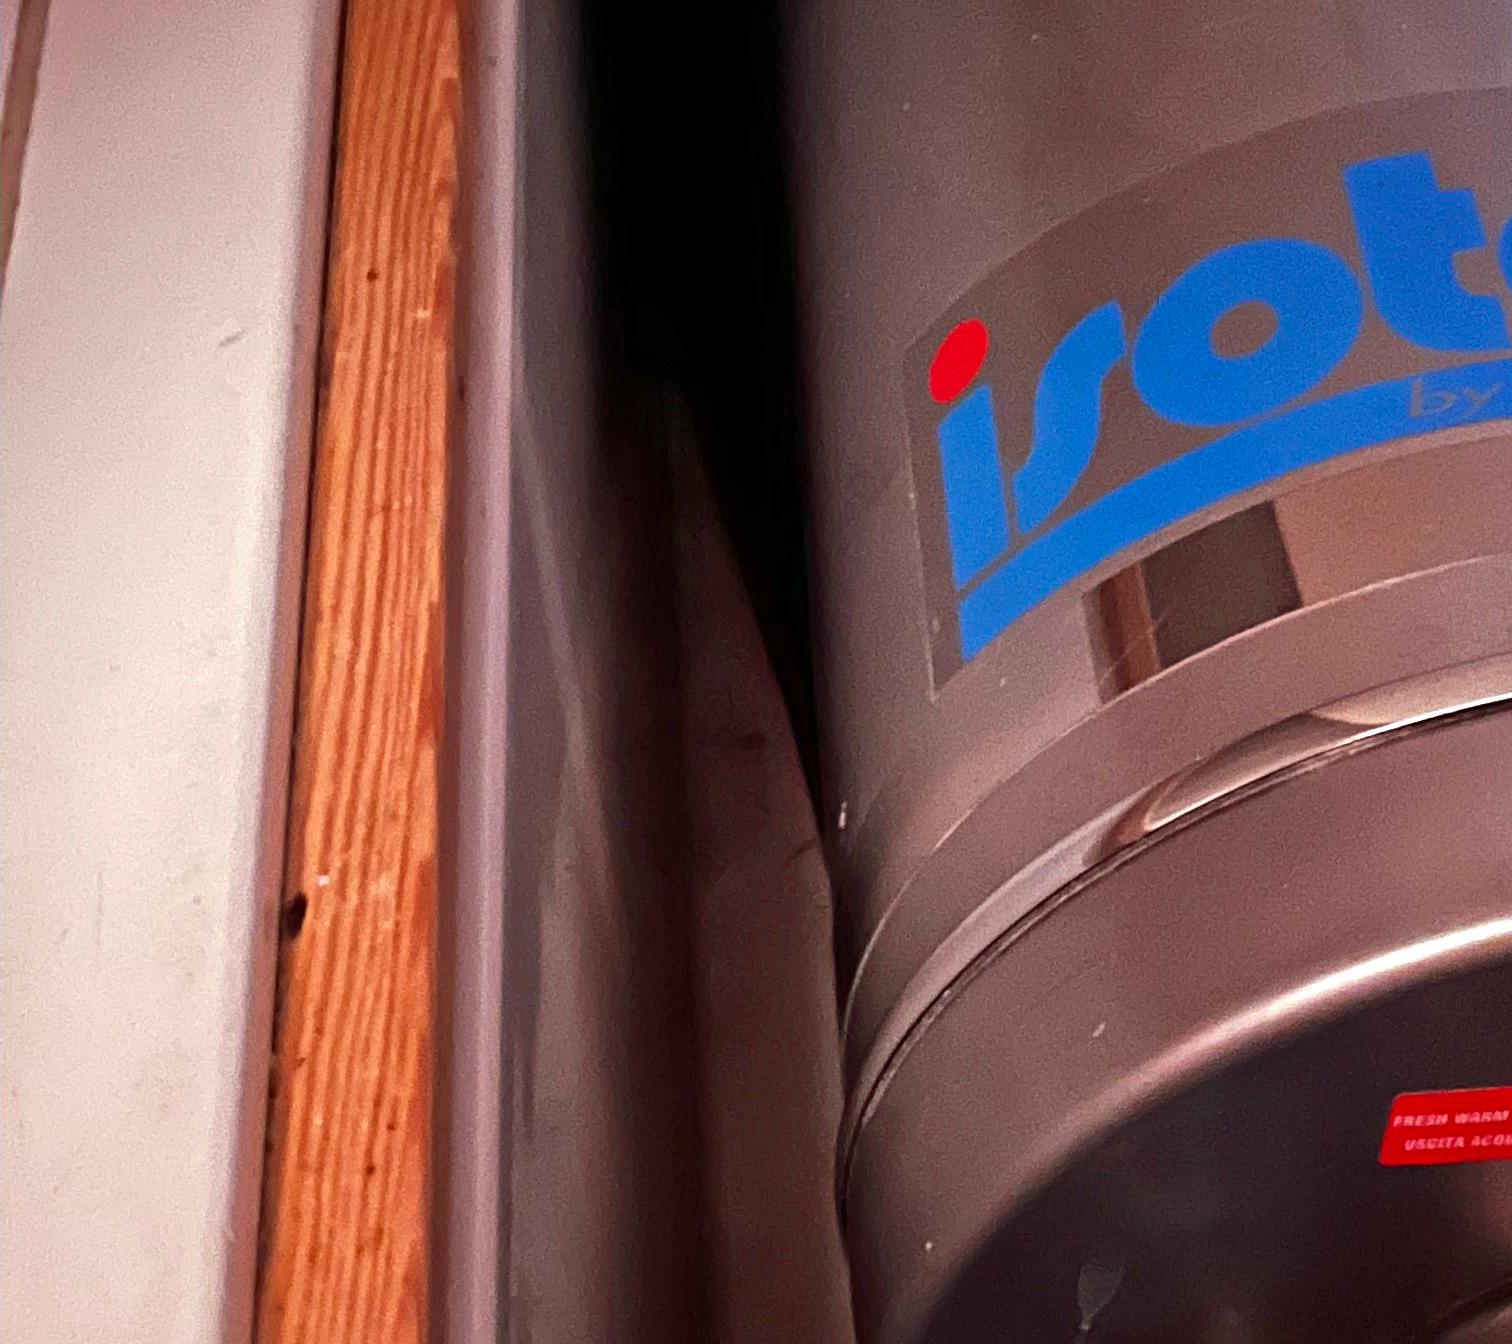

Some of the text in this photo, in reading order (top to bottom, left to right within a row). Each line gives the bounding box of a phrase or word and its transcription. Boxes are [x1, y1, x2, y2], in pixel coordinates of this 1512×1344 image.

[1406, 375, 1502, 421] by
[1393, 1113, 1448, 1128] FRESH
[1454, 1109, 1510, 1125] WARM
[1404, 1135, 1465, 1151] USCITA
